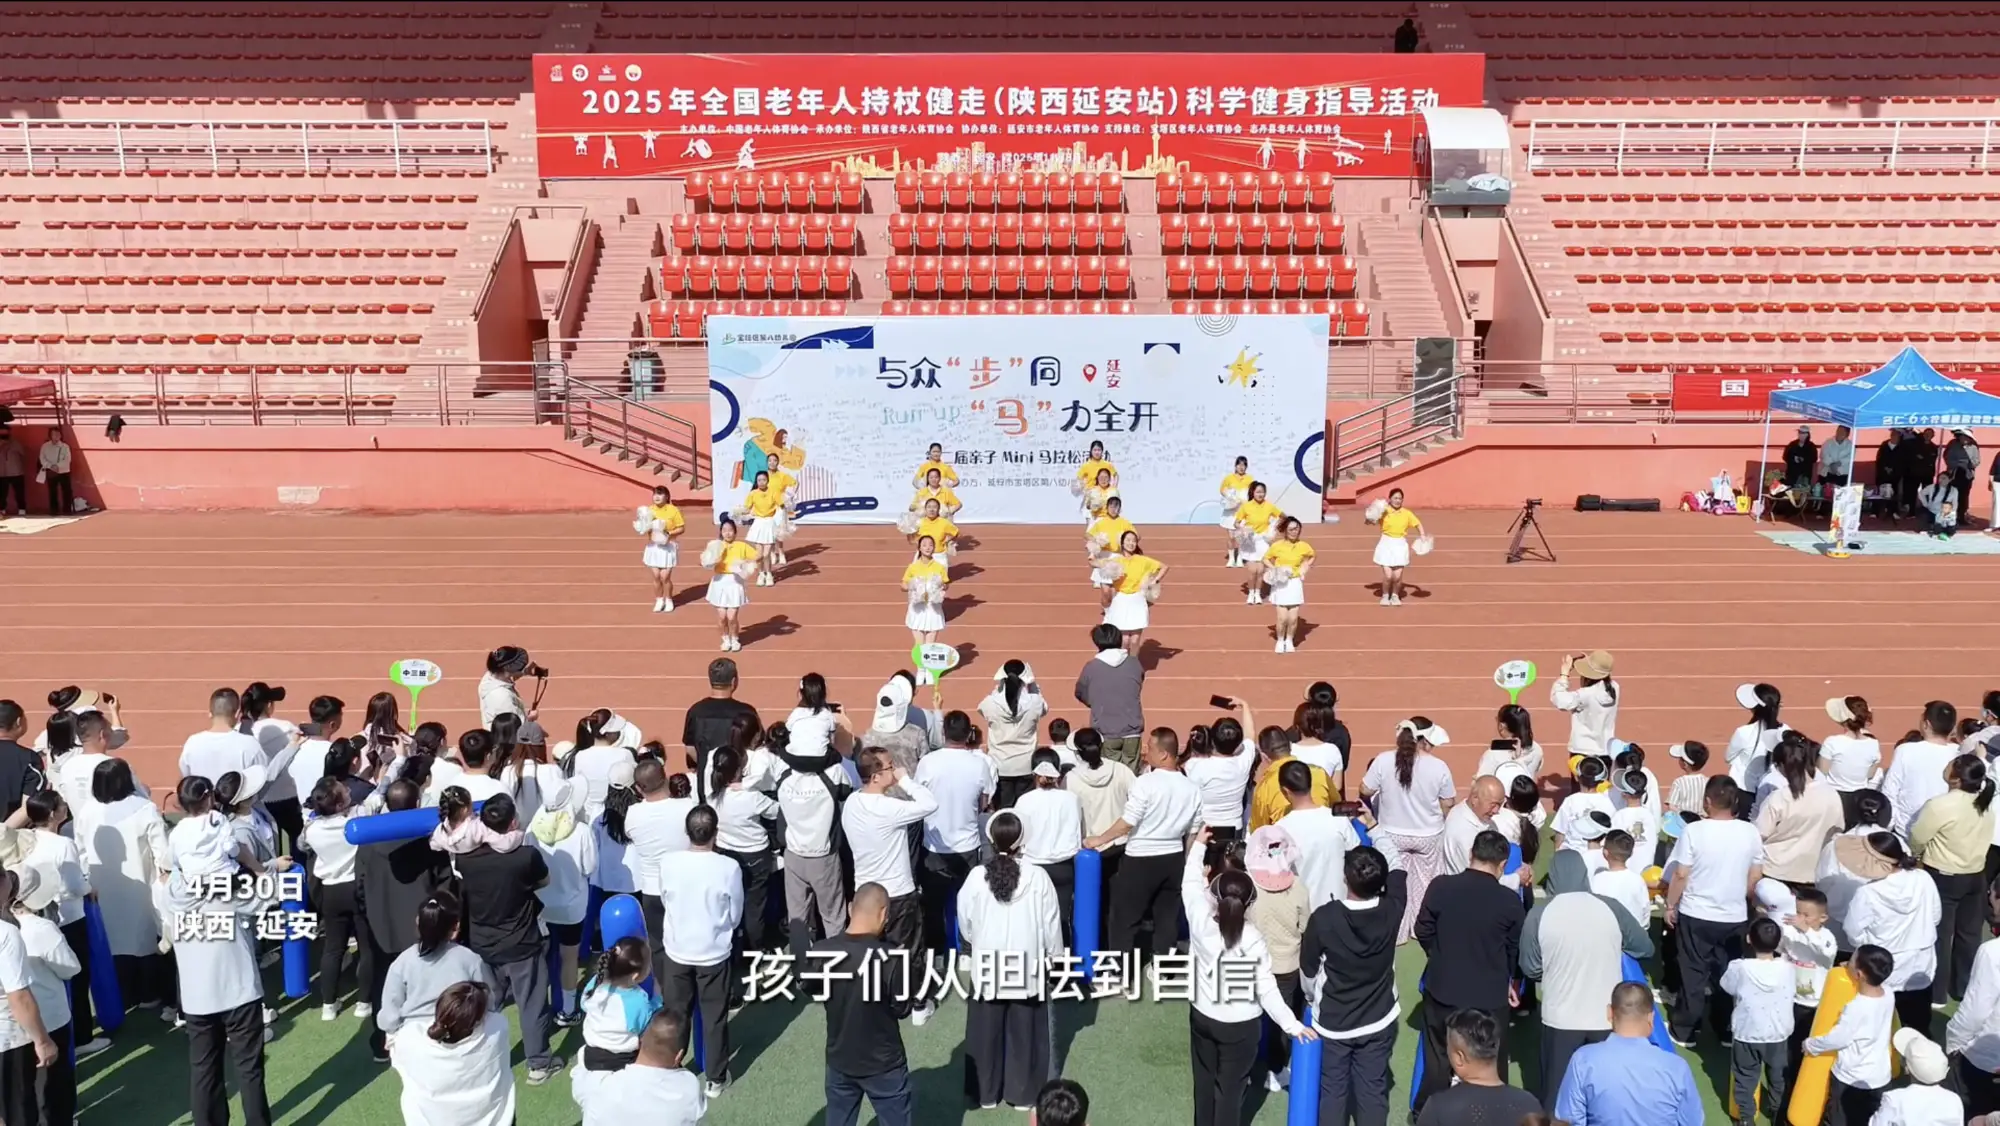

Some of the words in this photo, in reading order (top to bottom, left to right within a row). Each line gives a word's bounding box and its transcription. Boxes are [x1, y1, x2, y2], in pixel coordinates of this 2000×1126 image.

[1106, 359, 1122, 388] 延安
[925, 450, 998, 465] 二届亲子
[1002, 450, 1034, 465] Mini
